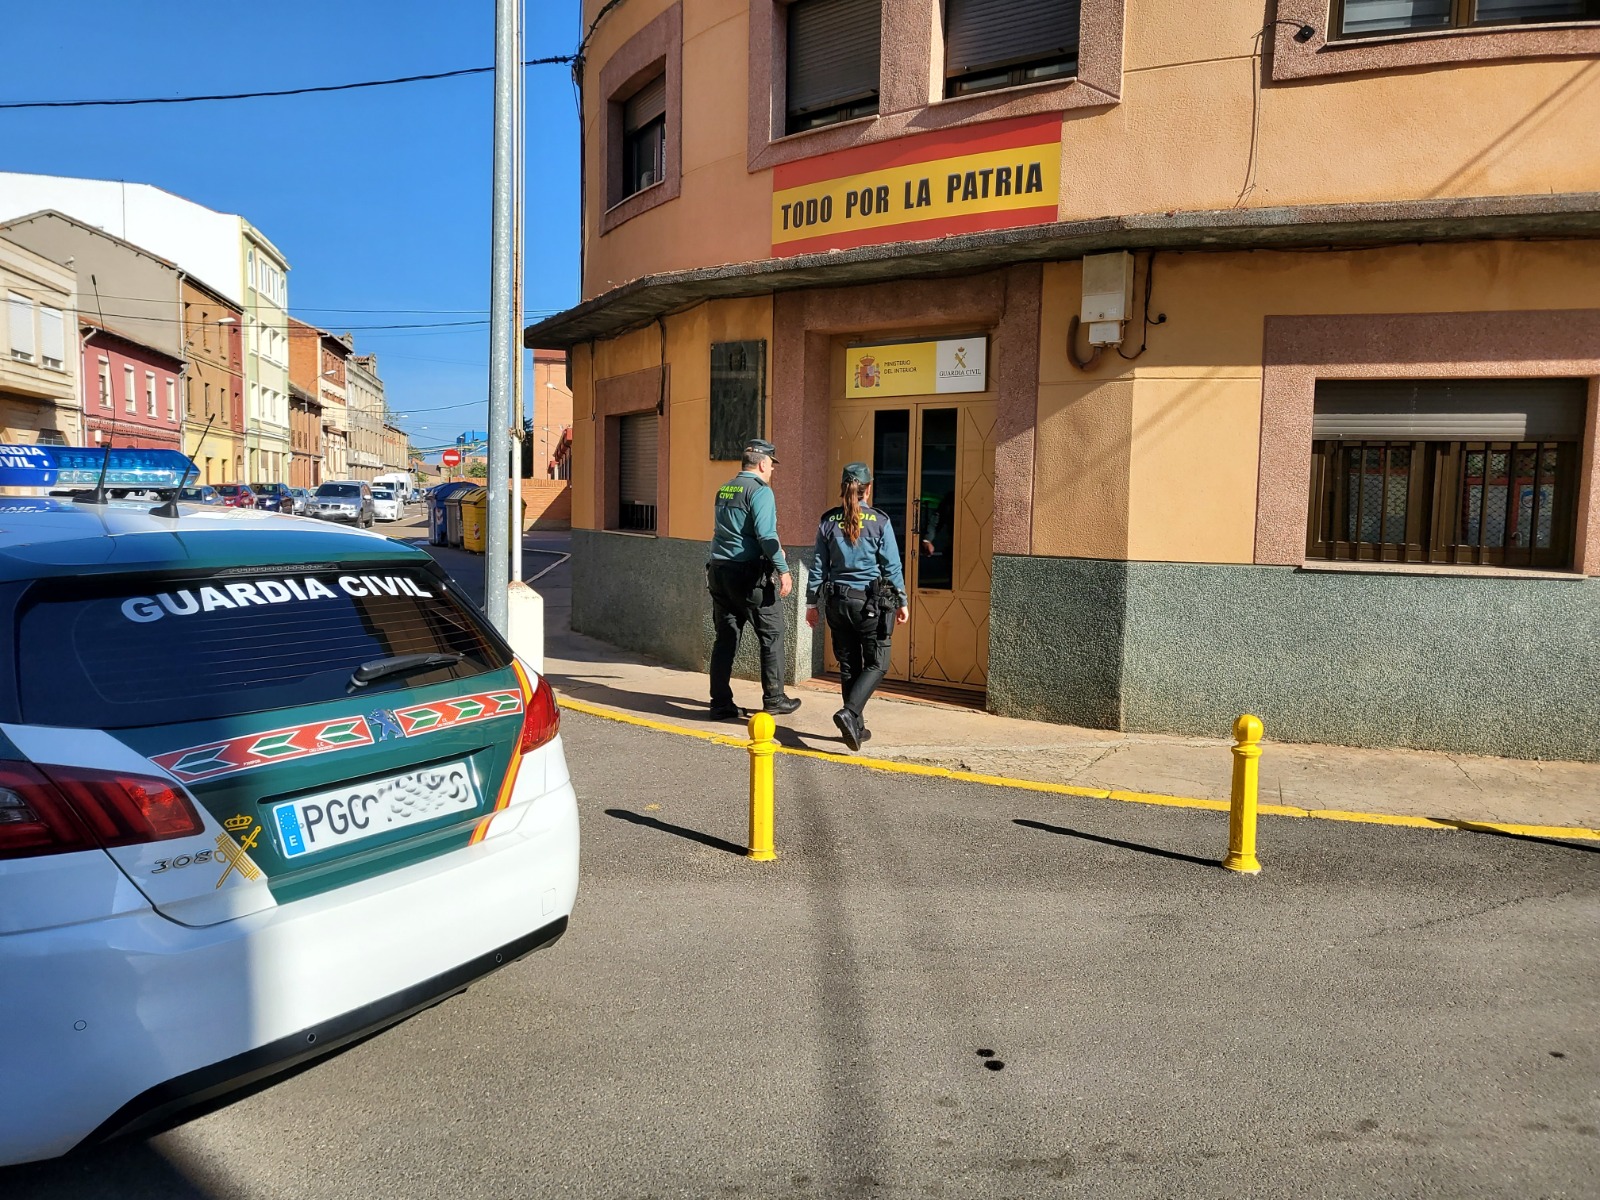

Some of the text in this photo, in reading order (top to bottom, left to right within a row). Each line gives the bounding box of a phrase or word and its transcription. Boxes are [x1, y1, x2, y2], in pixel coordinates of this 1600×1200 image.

[781, 162, 1043, 230] TODO POR LA PATRIA
[718, 485, 744, 493] UARDIA
[829, 512, 877, 522] GUDIA
[838, 521, 864, 529] CL
[120, 575, 433, 623] GUARDIA CIVIL
[289, 835, 298, 847] E
[151, 848, 213, 874] 308
